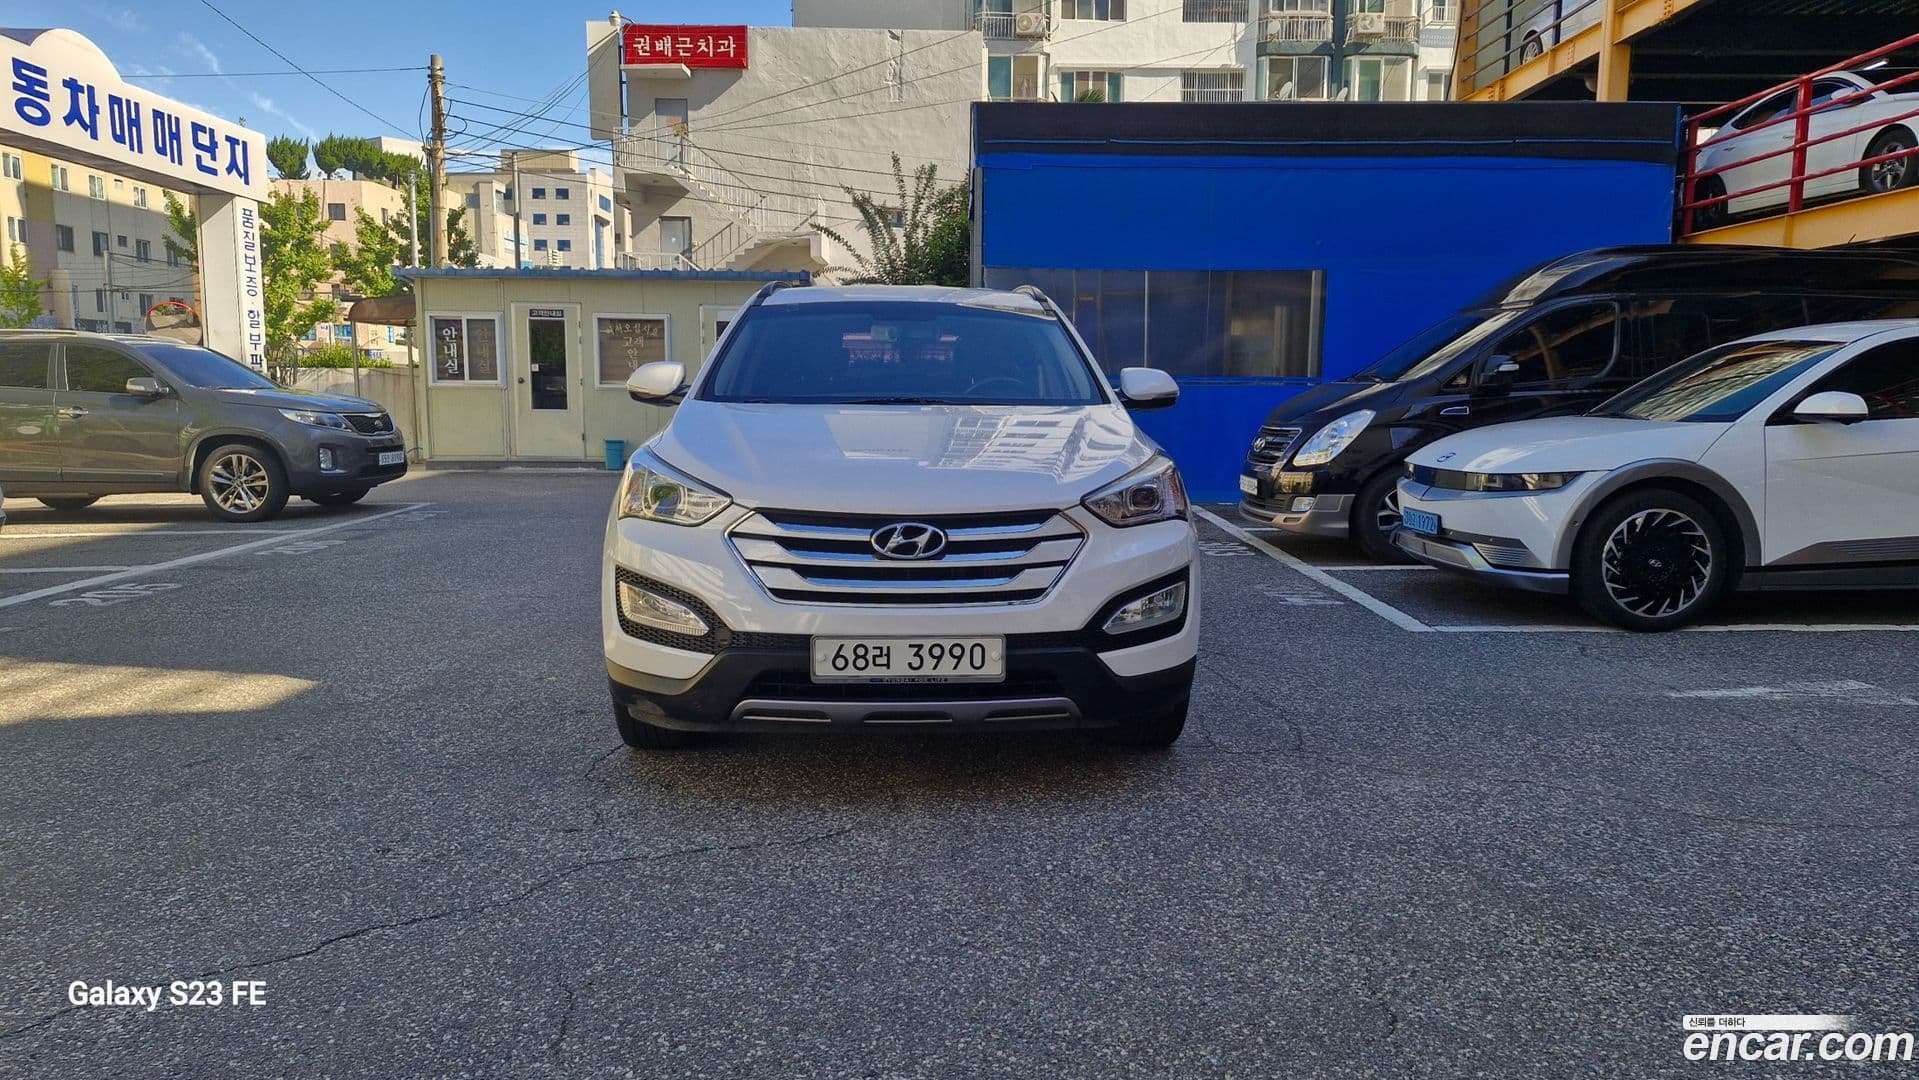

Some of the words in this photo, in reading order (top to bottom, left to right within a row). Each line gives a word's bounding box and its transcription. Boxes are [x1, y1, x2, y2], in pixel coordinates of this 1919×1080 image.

[633, 34, 736, 58] 권배근치과
[442, 326, 461, 375] 안내실
[831, 643, 891, 671] 68러
[907, 642, 986, 671] 3990
